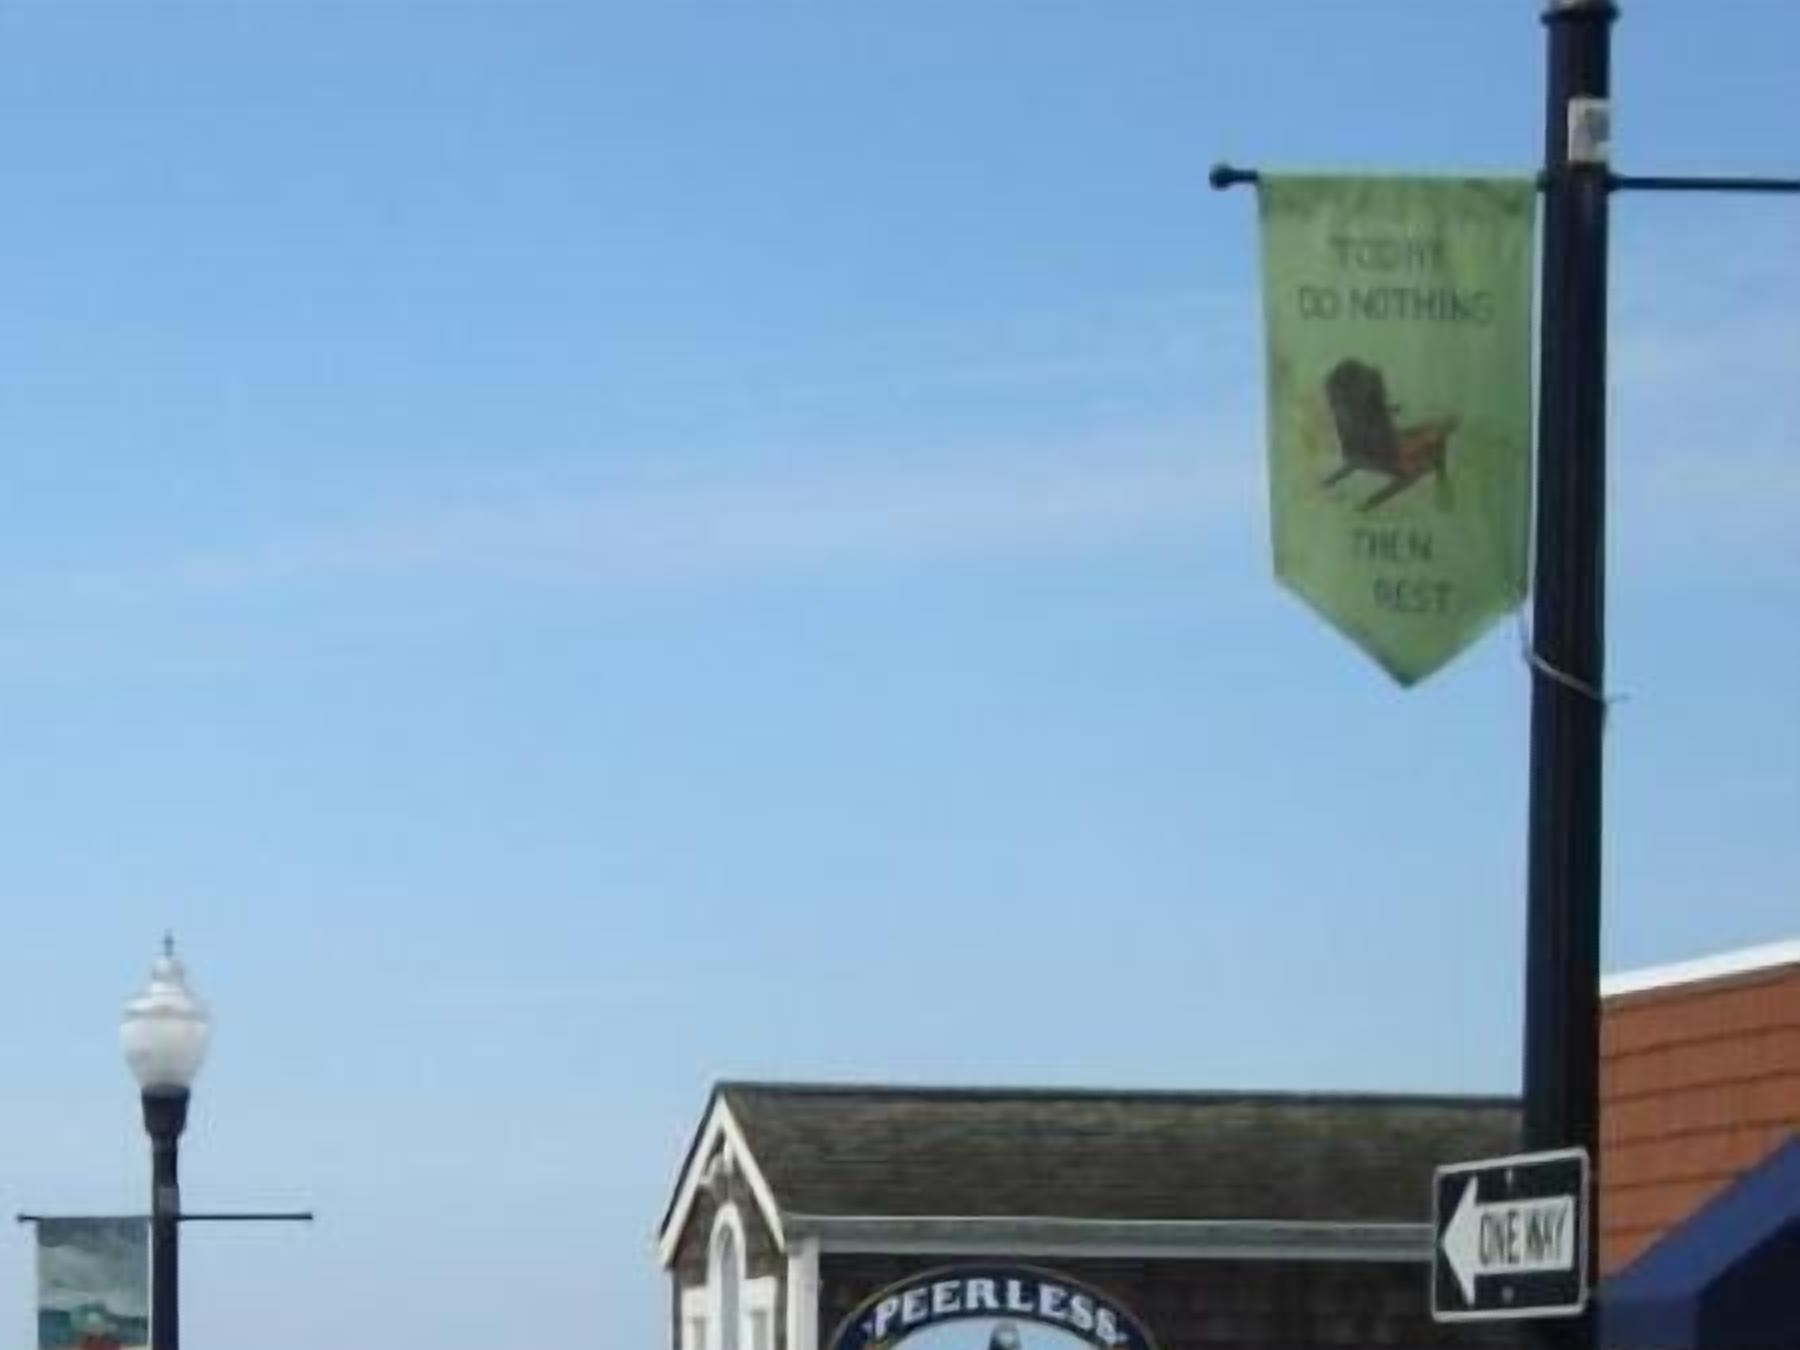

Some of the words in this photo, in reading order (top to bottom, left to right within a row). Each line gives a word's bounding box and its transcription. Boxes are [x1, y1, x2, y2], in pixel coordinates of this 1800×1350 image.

[1297, 286, 1338, 320] DO
[1349, 286, 1497, 323] NOTHING
[1479, 1209, 1520, 1266] ONE
[874, 1277, 1119, 1346] PEERLESS
